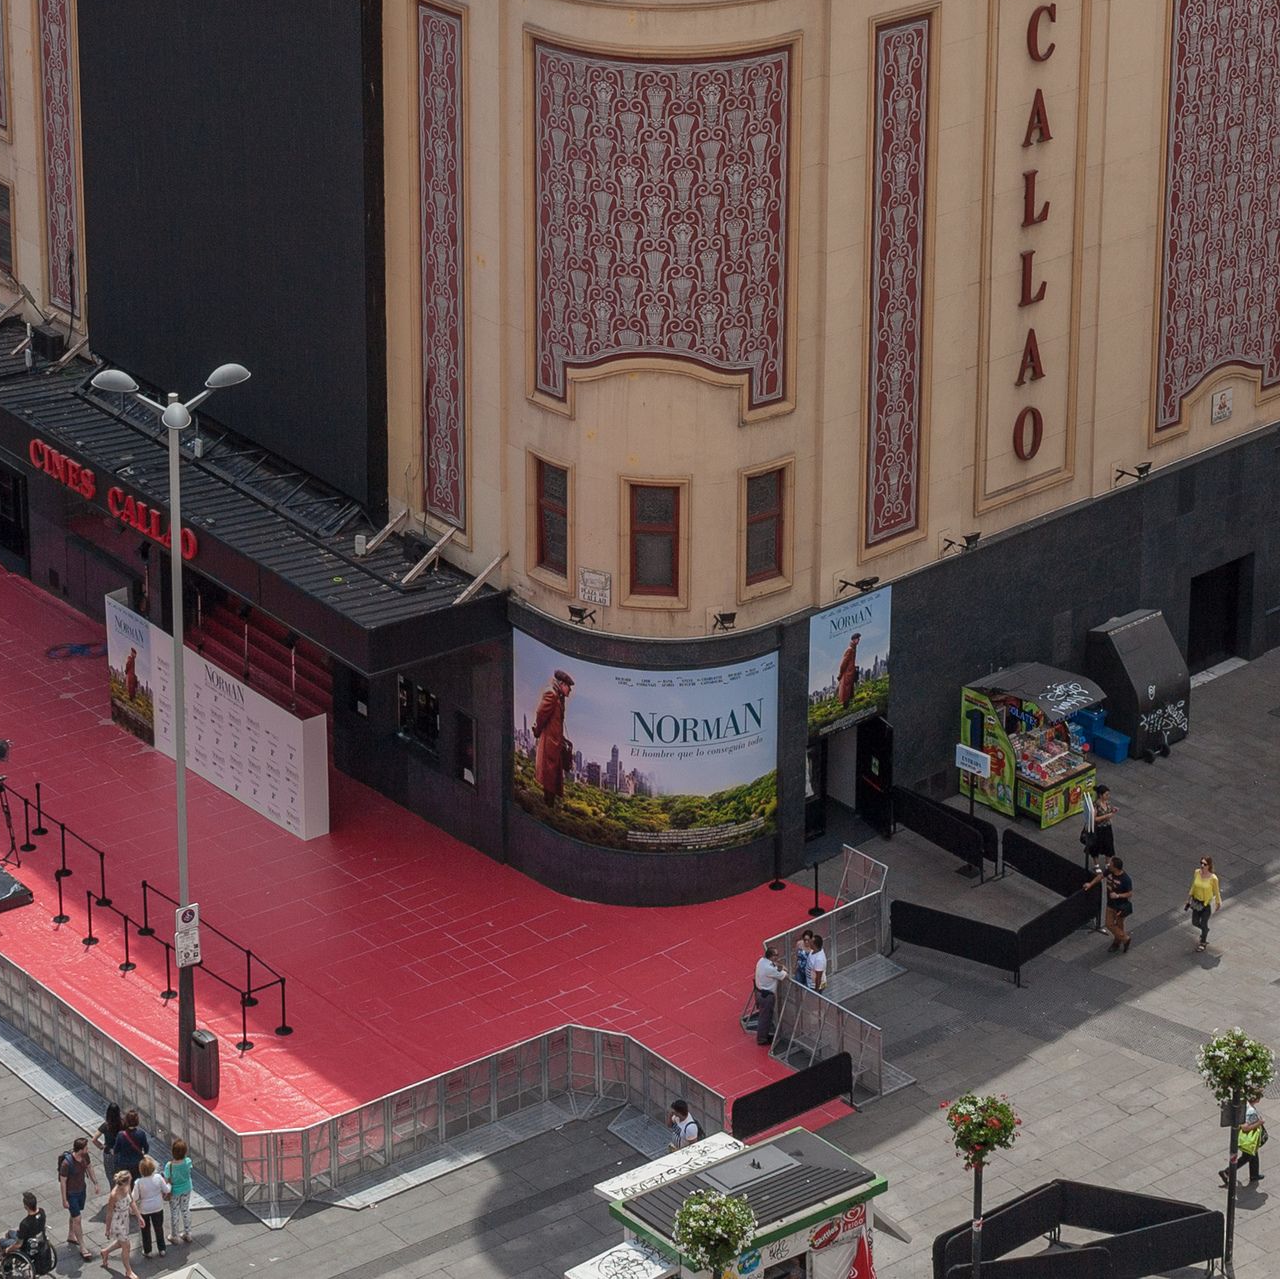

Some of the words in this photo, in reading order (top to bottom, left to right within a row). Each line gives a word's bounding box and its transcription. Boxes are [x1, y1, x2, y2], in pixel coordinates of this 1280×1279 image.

[1013, 3, 1057, 461] CALLAO
[29, 438, 96, 500] CINES
[829, 605, 873, 632] NORMAN
[205, 664, 245, 704] NORMAN
[630, 698, 764, 743] NORMAN
[631, 747, 640, 756] El
[642, 747, 675, 758] hombre
[677, 751, 694, 760] que
[696, 745, 705, 756] lo
[748, 736, 763, 747] todo
[844, 1219, 863, 1232] FRIGO
